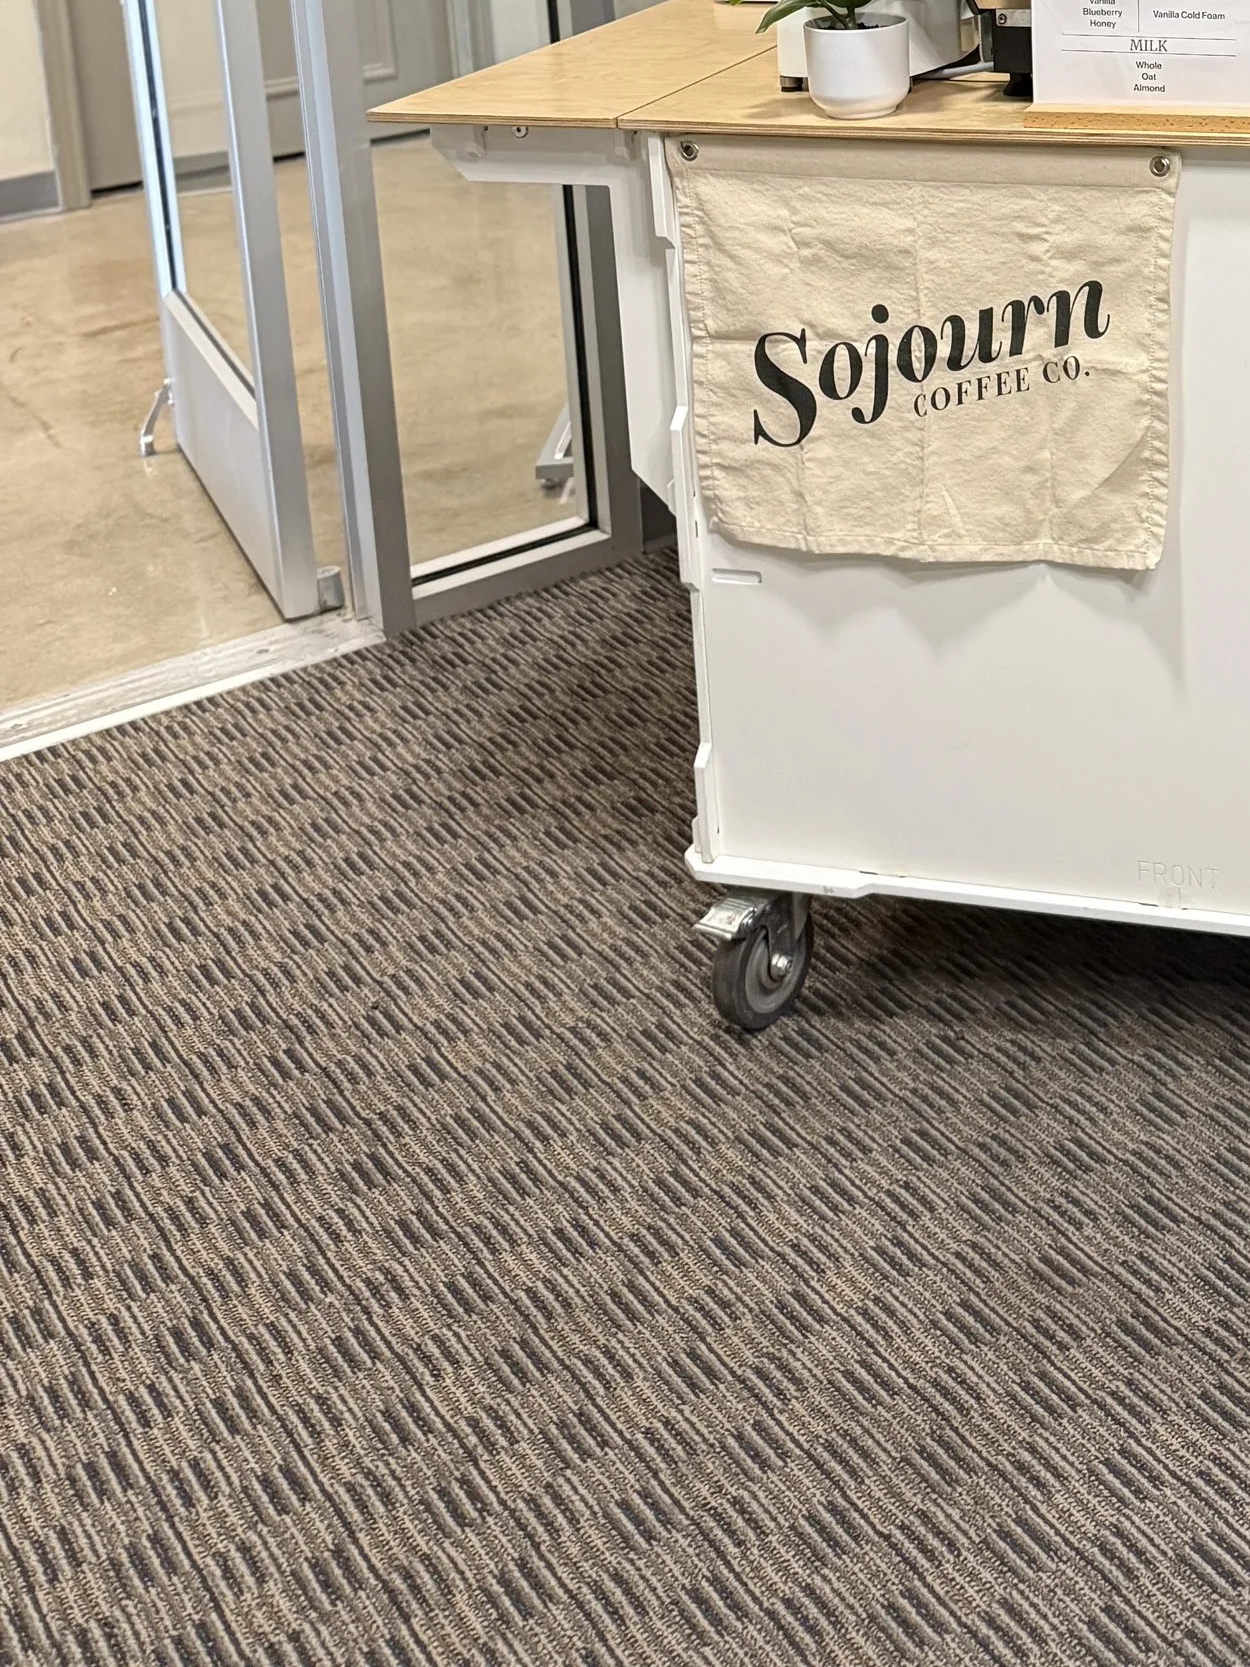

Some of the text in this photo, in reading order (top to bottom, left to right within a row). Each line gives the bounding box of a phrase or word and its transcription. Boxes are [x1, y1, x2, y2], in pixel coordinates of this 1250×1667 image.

[1082, 7, 1123, 18] Blueberry
[1152, 9, 1226, 20] Vanilla Cold Foam
[1089, 19, 1117, 29] Honey
[1129, 39, 1168, 52] MILK
[1135, 60, 1163, 70] Whole
[1141, 72, 1157, 81] Oat
[1133, 83, 1166, 93] Almond
[754, 280, 1110, 447] Sojourn
[913, 355, 1091, 418] COFFEE CO.
[1137, 860, 1220, 890] FRONT
